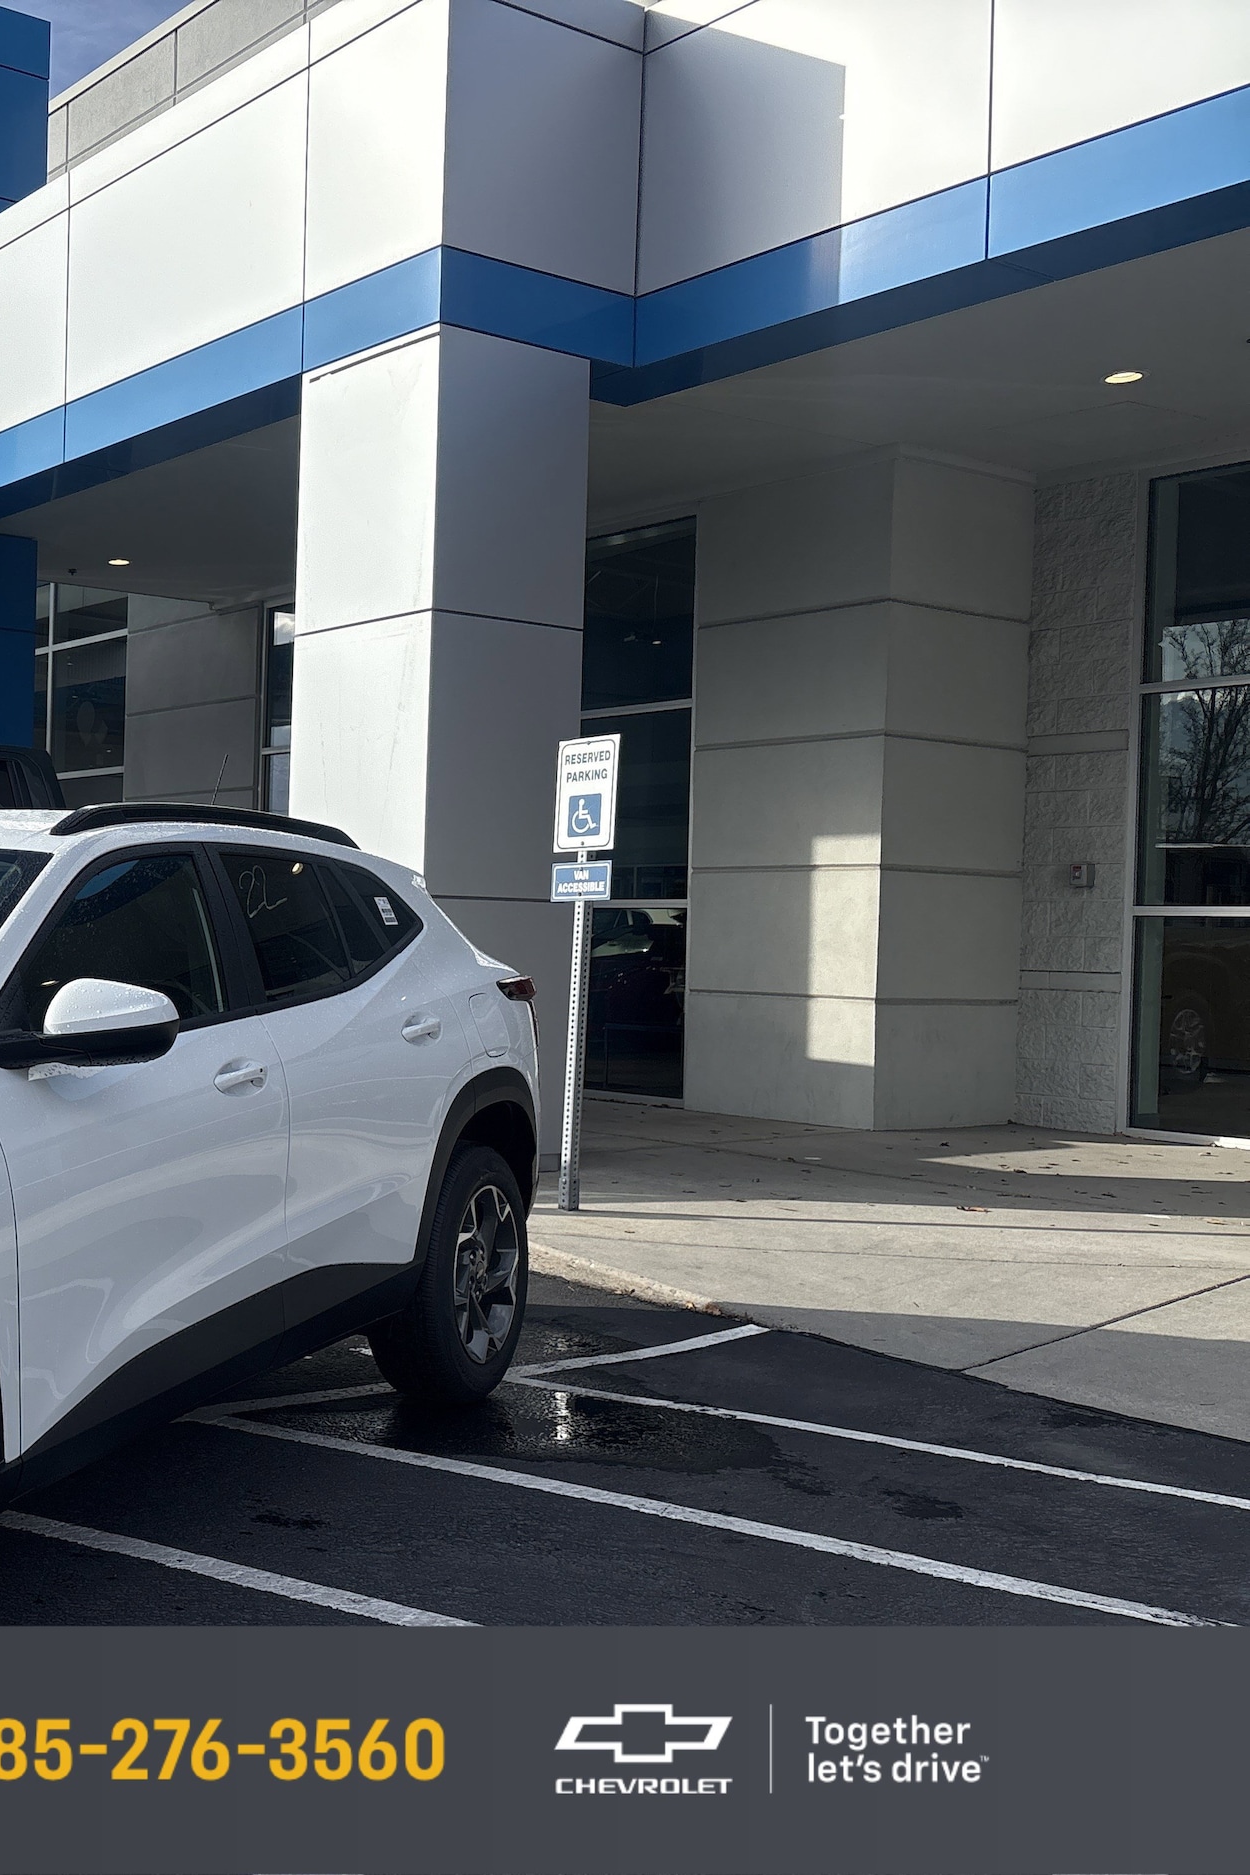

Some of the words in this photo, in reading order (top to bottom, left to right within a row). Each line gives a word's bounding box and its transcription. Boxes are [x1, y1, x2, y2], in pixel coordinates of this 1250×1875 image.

[564, 750, 611, 766] RESERVED
[566, 768, 608, 783] PARKING
[573, 869, 589, 881] VAN
[557, 880, 606, 894] ACCESSIBLE
